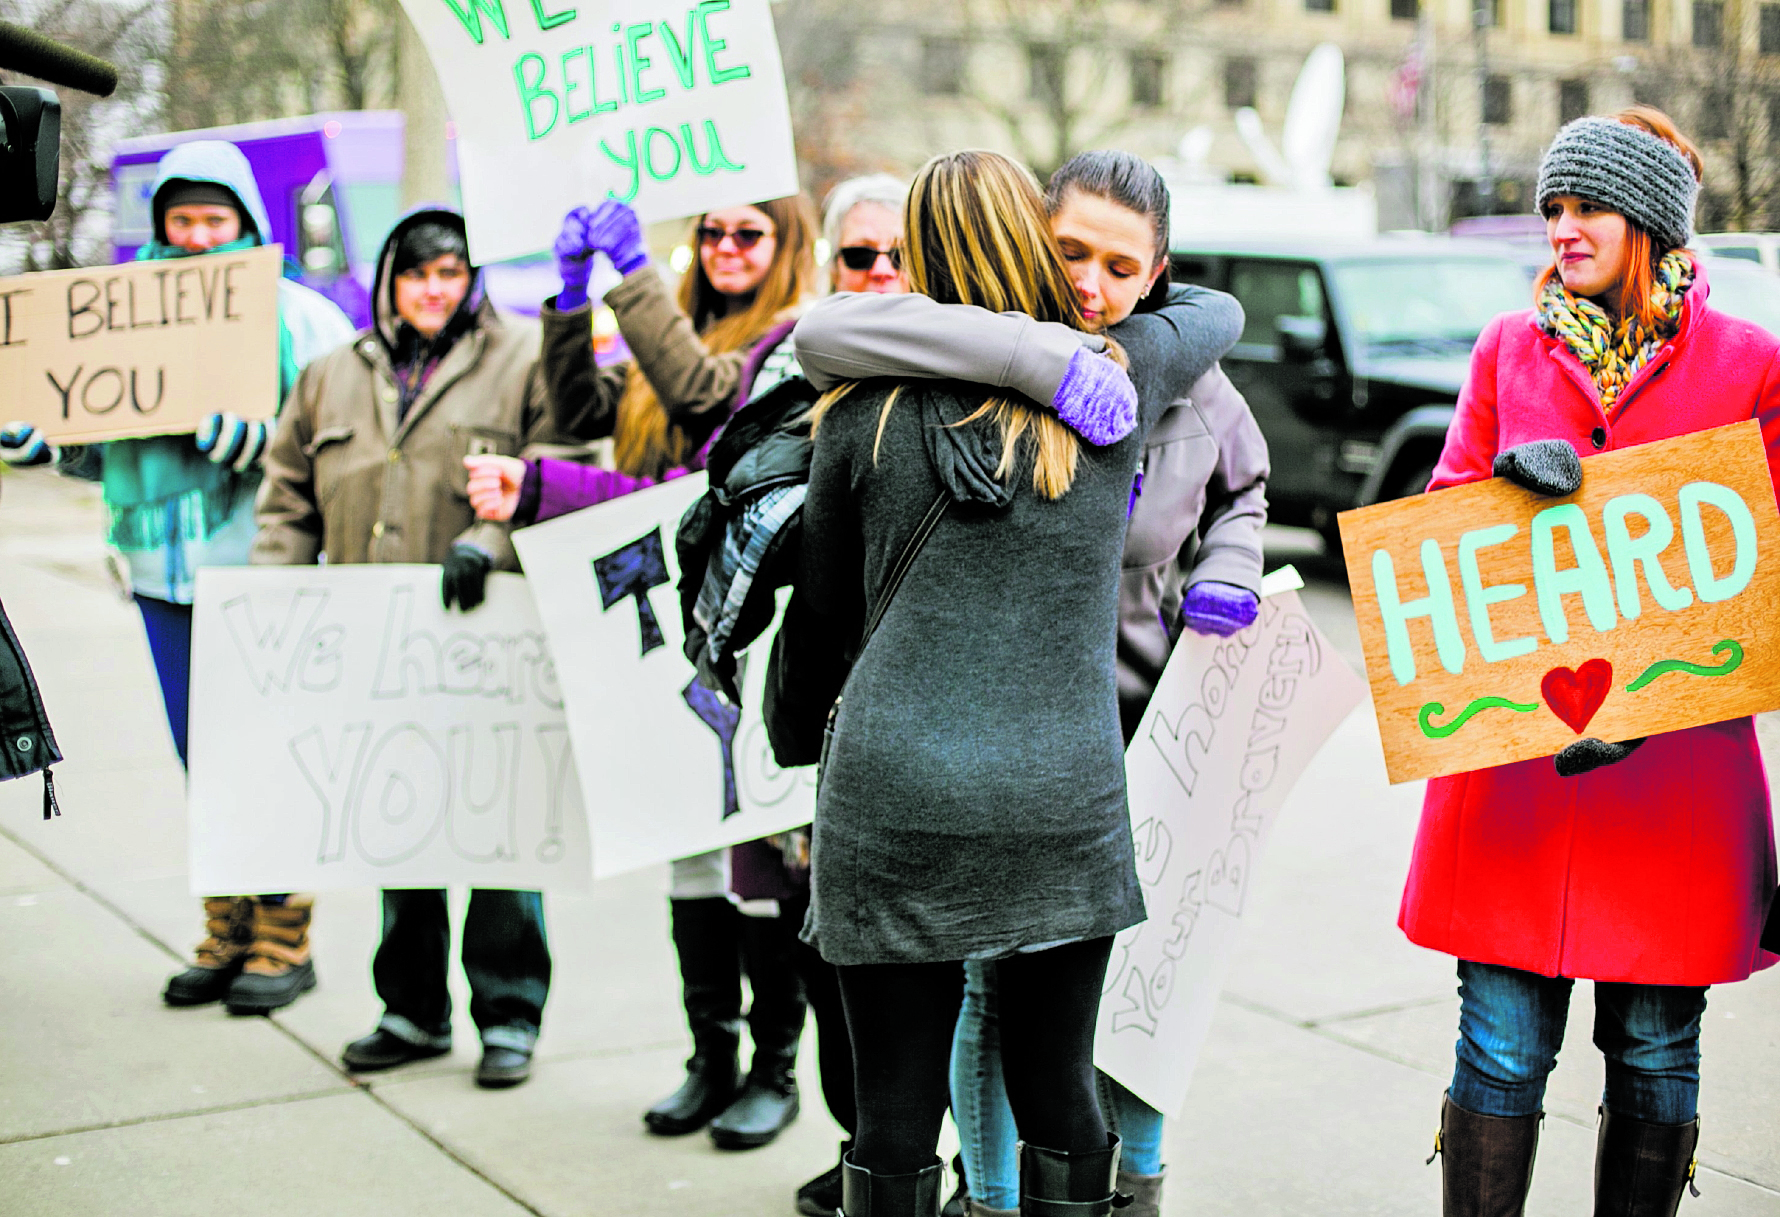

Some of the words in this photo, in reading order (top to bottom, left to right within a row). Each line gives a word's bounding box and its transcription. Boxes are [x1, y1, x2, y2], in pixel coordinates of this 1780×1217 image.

[0, 288, 34, 346] I
[67, 262, 247, 339] BELIEVE
[46, 365, 164, 420] YOU
[220, 587, 346, 696] We
[1371, 481, 1758, 687] HEARD
[288, 721, 573, 867] YOU!
[1112, 869, 1201, 1037] Your
[1204, 613, 1322, 918] Bravery
